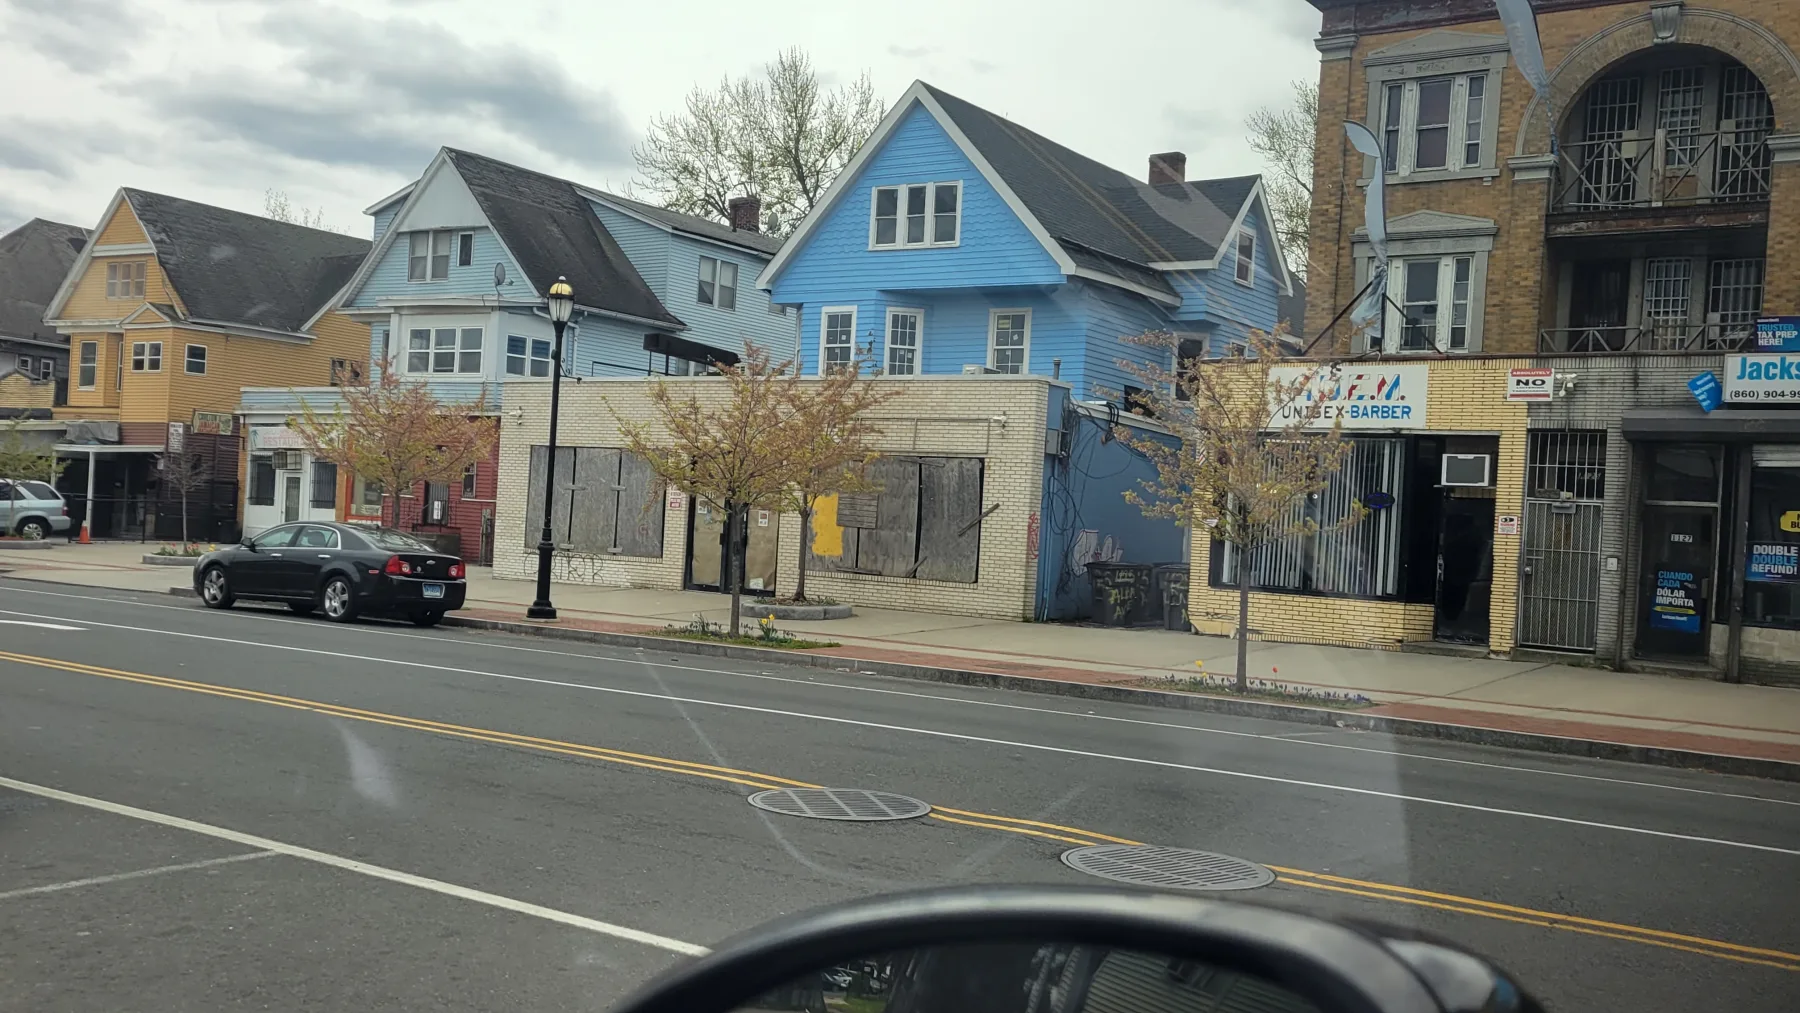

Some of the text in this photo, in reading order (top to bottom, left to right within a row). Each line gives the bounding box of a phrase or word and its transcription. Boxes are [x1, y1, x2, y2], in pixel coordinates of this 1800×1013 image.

[1729, 390, 1759, 400] (860)
[1282, 404, 1412, 419] UNISEX-BARBER
[1753, 545, 1799, 556] DOUBLE
[1752, 555, 1798, 566] DOUBLE
[1751, 564, 1798, 575] REFUND!
[1658, 571, 1693, 580] CUANDO
[1657, 579, 1680, 588] CADA
[1656, 587, 1685, 598] DÓLAR
[1656, 596, 1694, 607] IMPORTA
